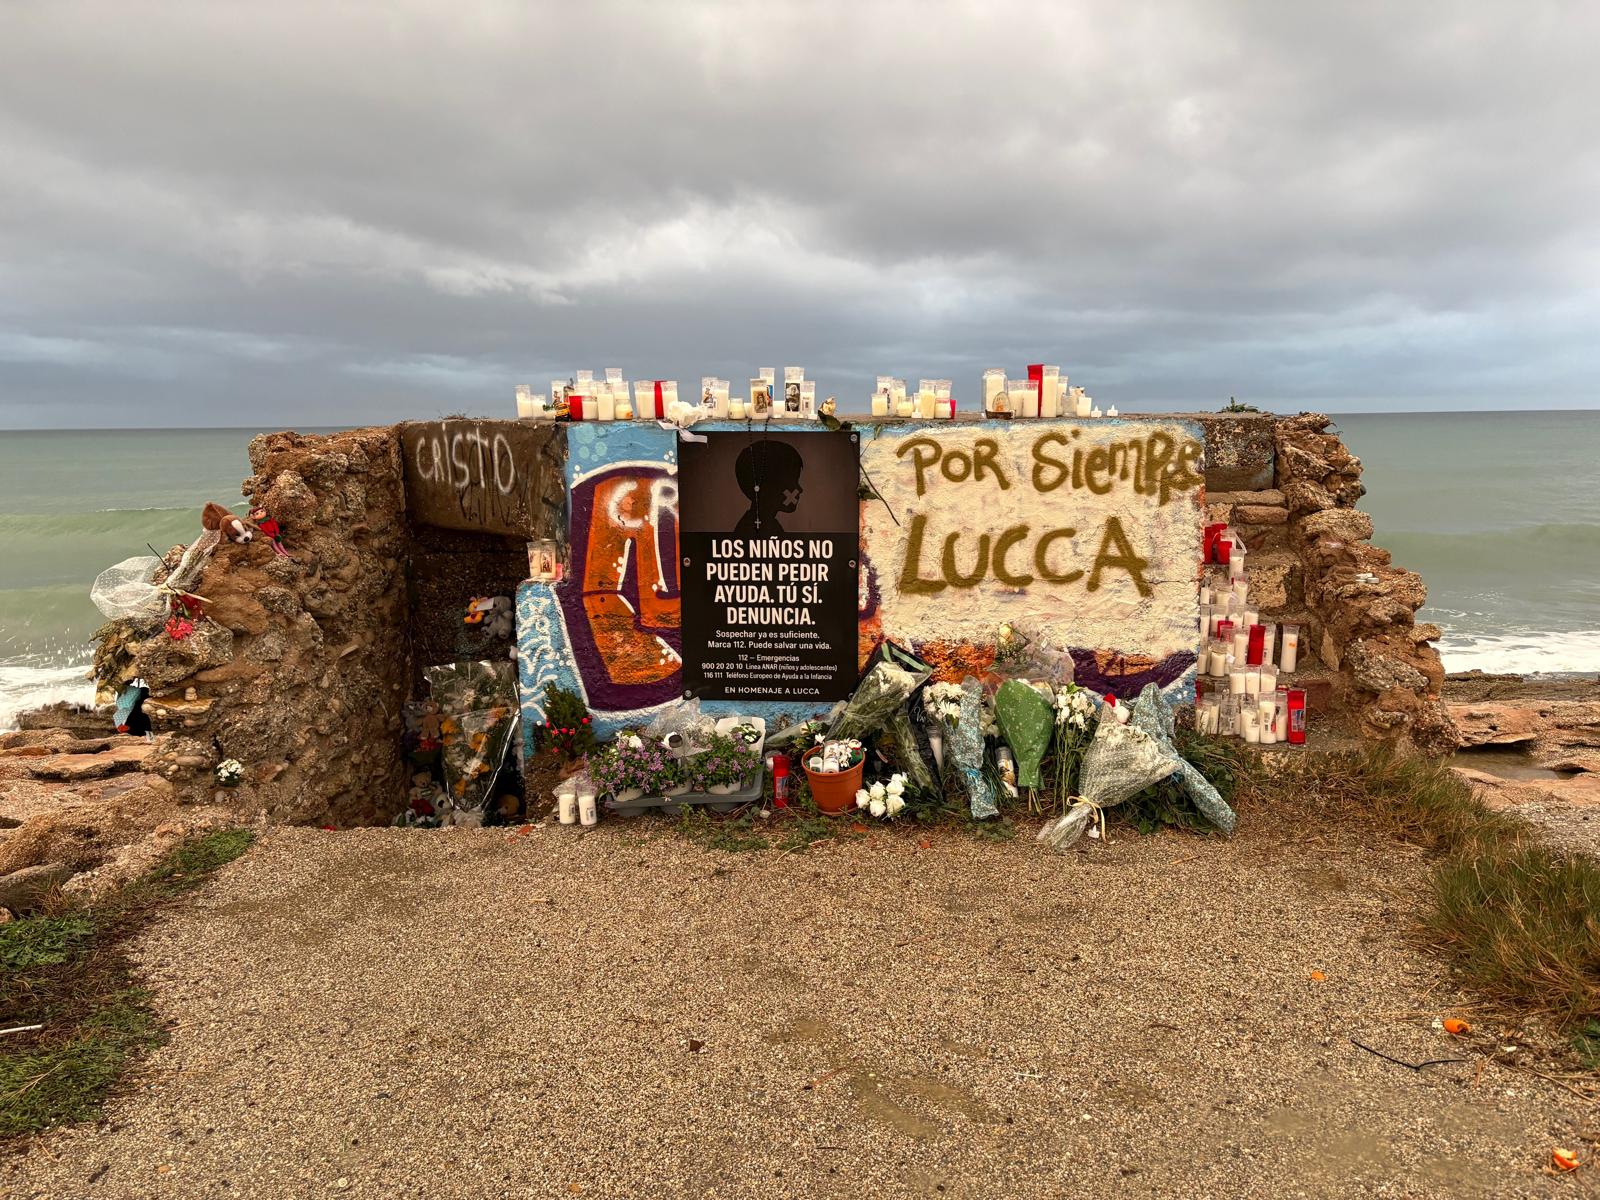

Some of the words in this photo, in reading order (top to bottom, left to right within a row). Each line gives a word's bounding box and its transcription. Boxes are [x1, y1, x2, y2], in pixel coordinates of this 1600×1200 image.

[711, 539, 745, 559] LOS
[749, 536, 805, 559] NIÑOS
[808, 539, 834, 559] NO
[896, 514, 1153, 597] LUCCA
[706, 562, 773, 582] PUEDEN
[778, 563, 829, 582] PEDIR
[714, 585, 775, 604] AYUDA.
[776, 582, 799, 604] TÚ
[801, 582, 823, 604] SÍ.
[726, 606, 816, 626] DENUNCIA.
[715, 629, 757, 640] Sospechar
[757, 631, 768, 640] ya
[779, 630, 820, 639] suficiente.
[707, 640, 732, 649] Marca
[733, 640, 747, 649] 112.
[748, 640, 773, 649] Puede
[773, 641, 798, 650] salvar
[814, 641, 832, 650] vida.
[738, 654, 749, 662] 112
[756, 654, 800, 663] Emergencias
[799, 665, 838, 673] adolescentes)
[703, 671, 714, 679] 116
[714, 671, 723, 679] 111
[725, 671, 749, 679] Teléfono
[749, 672, 773, 681] Europeo
[773, 672, 781, 680] de
[781, 673, 799, 681] Ayuda
[724, 686, 736, 694] EN
[738, 686, 783, 695] HOMENAJE
[784, 687, 791, 695] A
[792, 687, 820, 695] LUCCA
